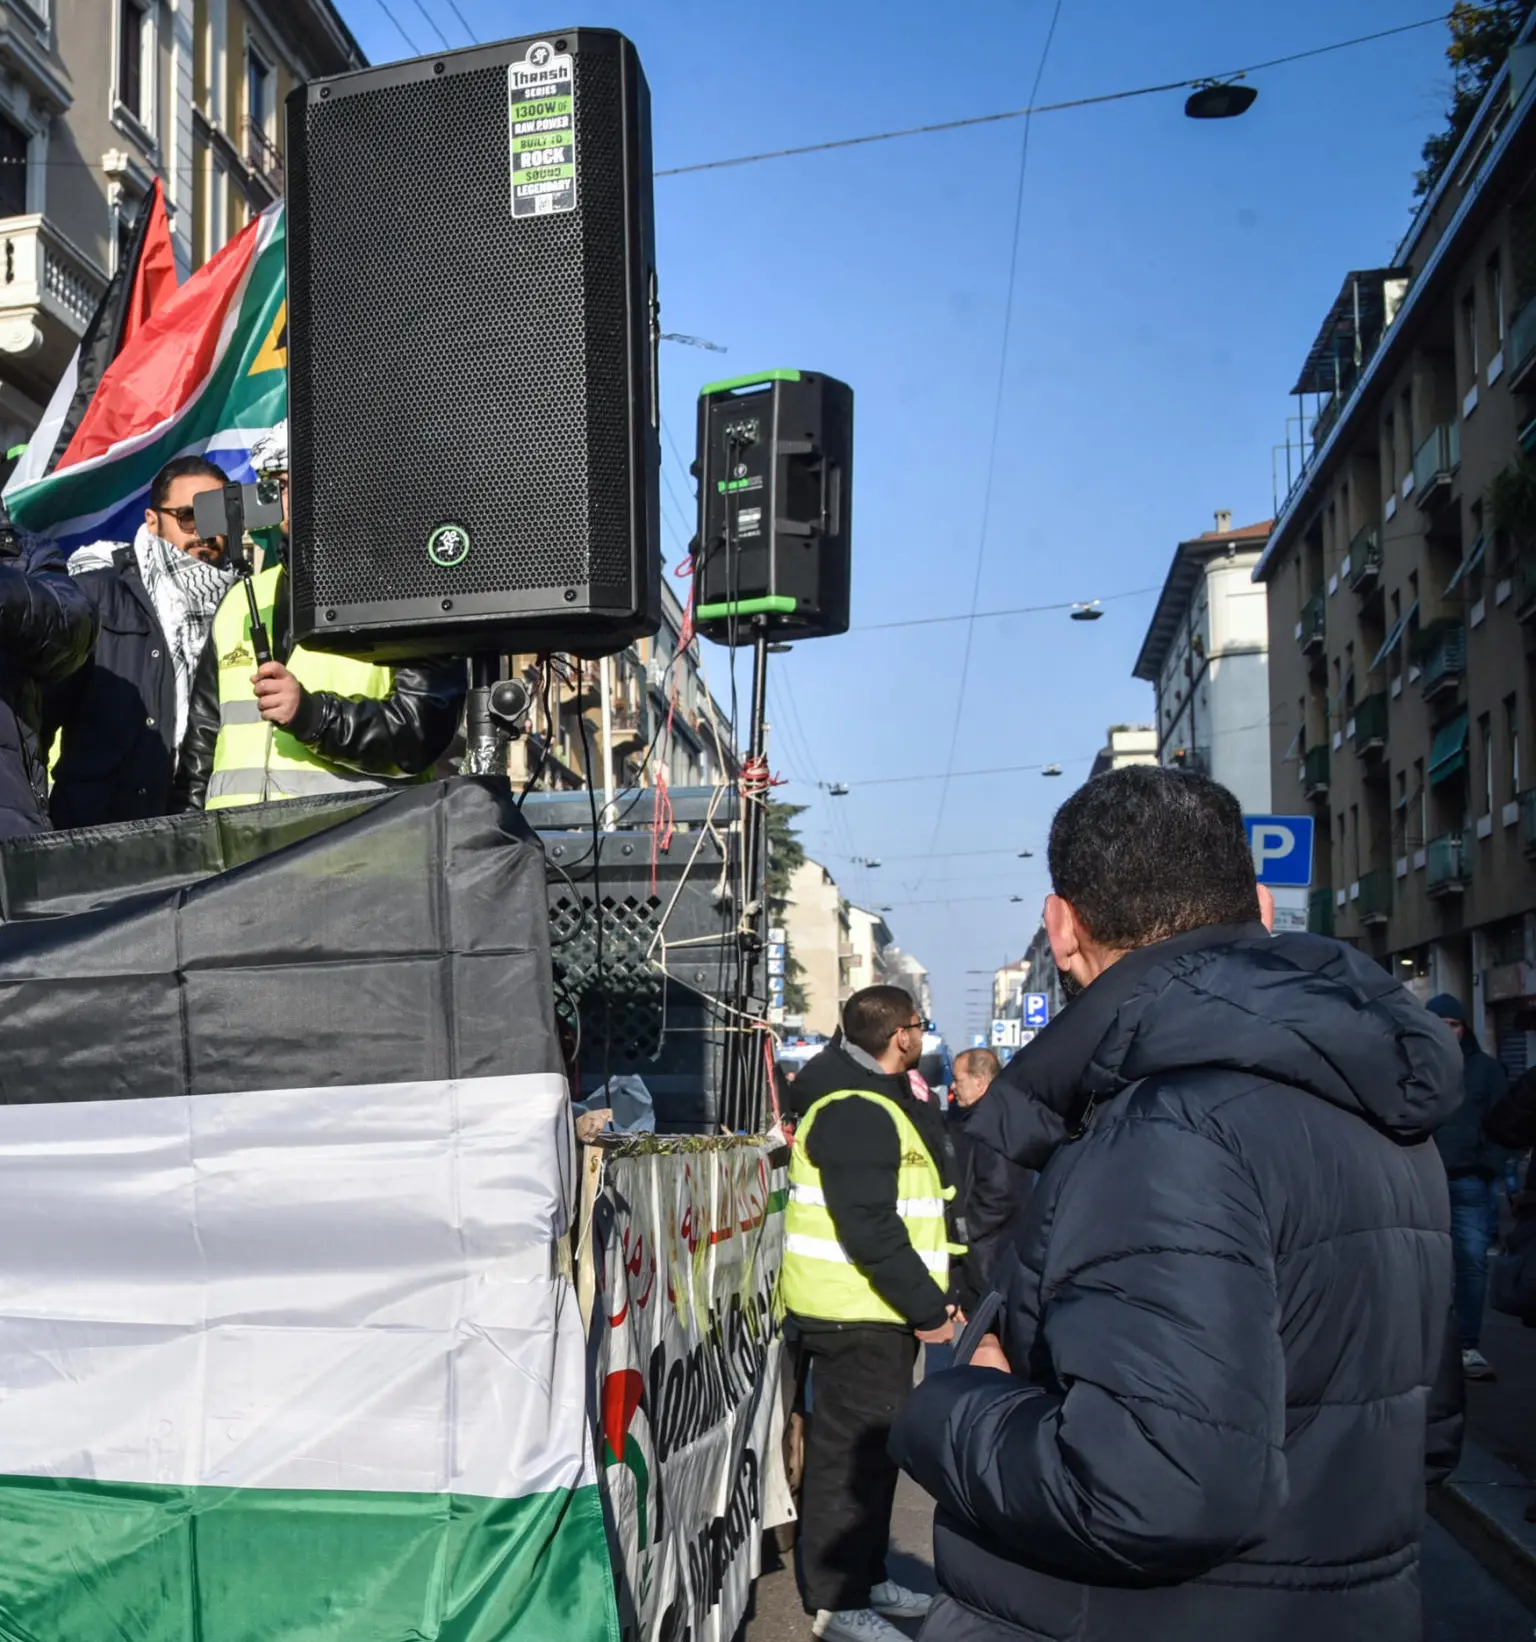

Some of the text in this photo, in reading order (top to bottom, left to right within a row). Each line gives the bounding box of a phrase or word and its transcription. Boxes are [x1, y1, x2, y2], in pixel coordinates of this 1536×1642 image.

[524, 84, 557, 98] SERIES
[515, 102, 556, 119] 1300W
[515, 116, 569, 135] RAW POWER
[520, 136, 547, 149] BUILT
[520, 147, 565, 168] ROCK
[526, 166, 561, 181] SOUND
[517, 178, 571, 197] LEGENDARY
[1252, 824, 1295, 876] P
[1028, 995, 1044, 1015] P
